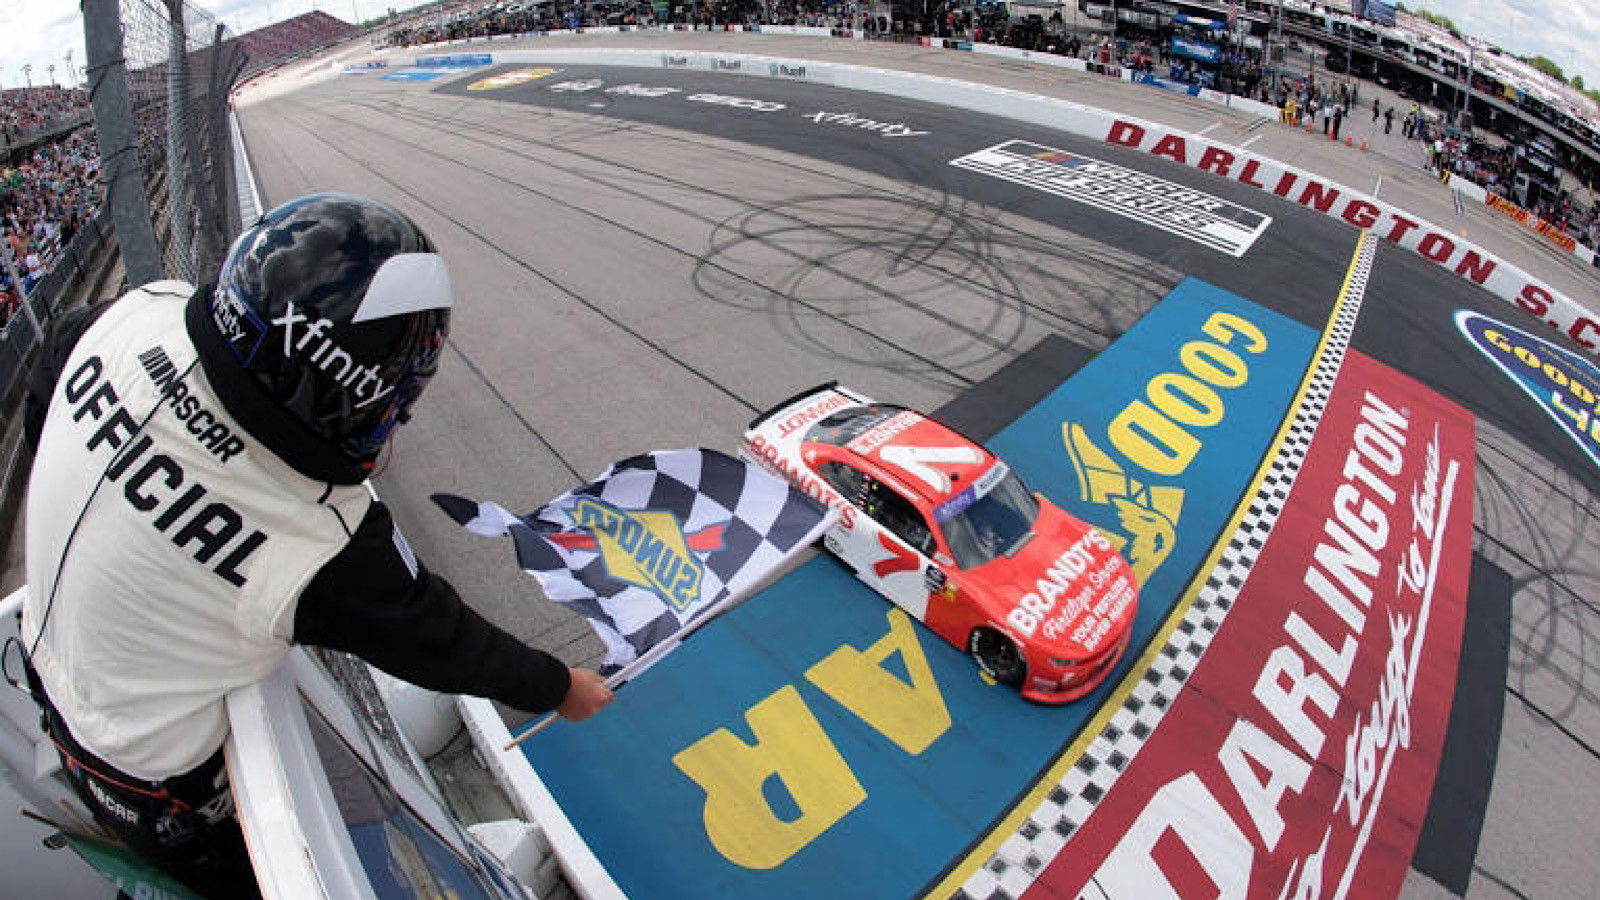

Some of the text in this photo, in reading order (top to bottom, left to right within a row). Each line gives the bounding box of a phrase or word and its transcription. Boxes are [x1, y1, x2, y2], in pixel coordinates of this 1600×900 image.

[1083, 158, 1224, 214] NASCAR
[1106, 119, 1498, 285] DARLINGTON
[272, 300, 396, 409] xfinity
[1108, 312, 1268, 477] GOOD
[1483, 329, 1600, 415] GOOD
[157, 367, 246, 464] NASCAR
[64, 355, 268, 588] OFFICIAL
[880, 445, 985, 494] 7
[872, 527, 921, 580] 7
[1006, 529, 1111, 638] BRANDT'S
